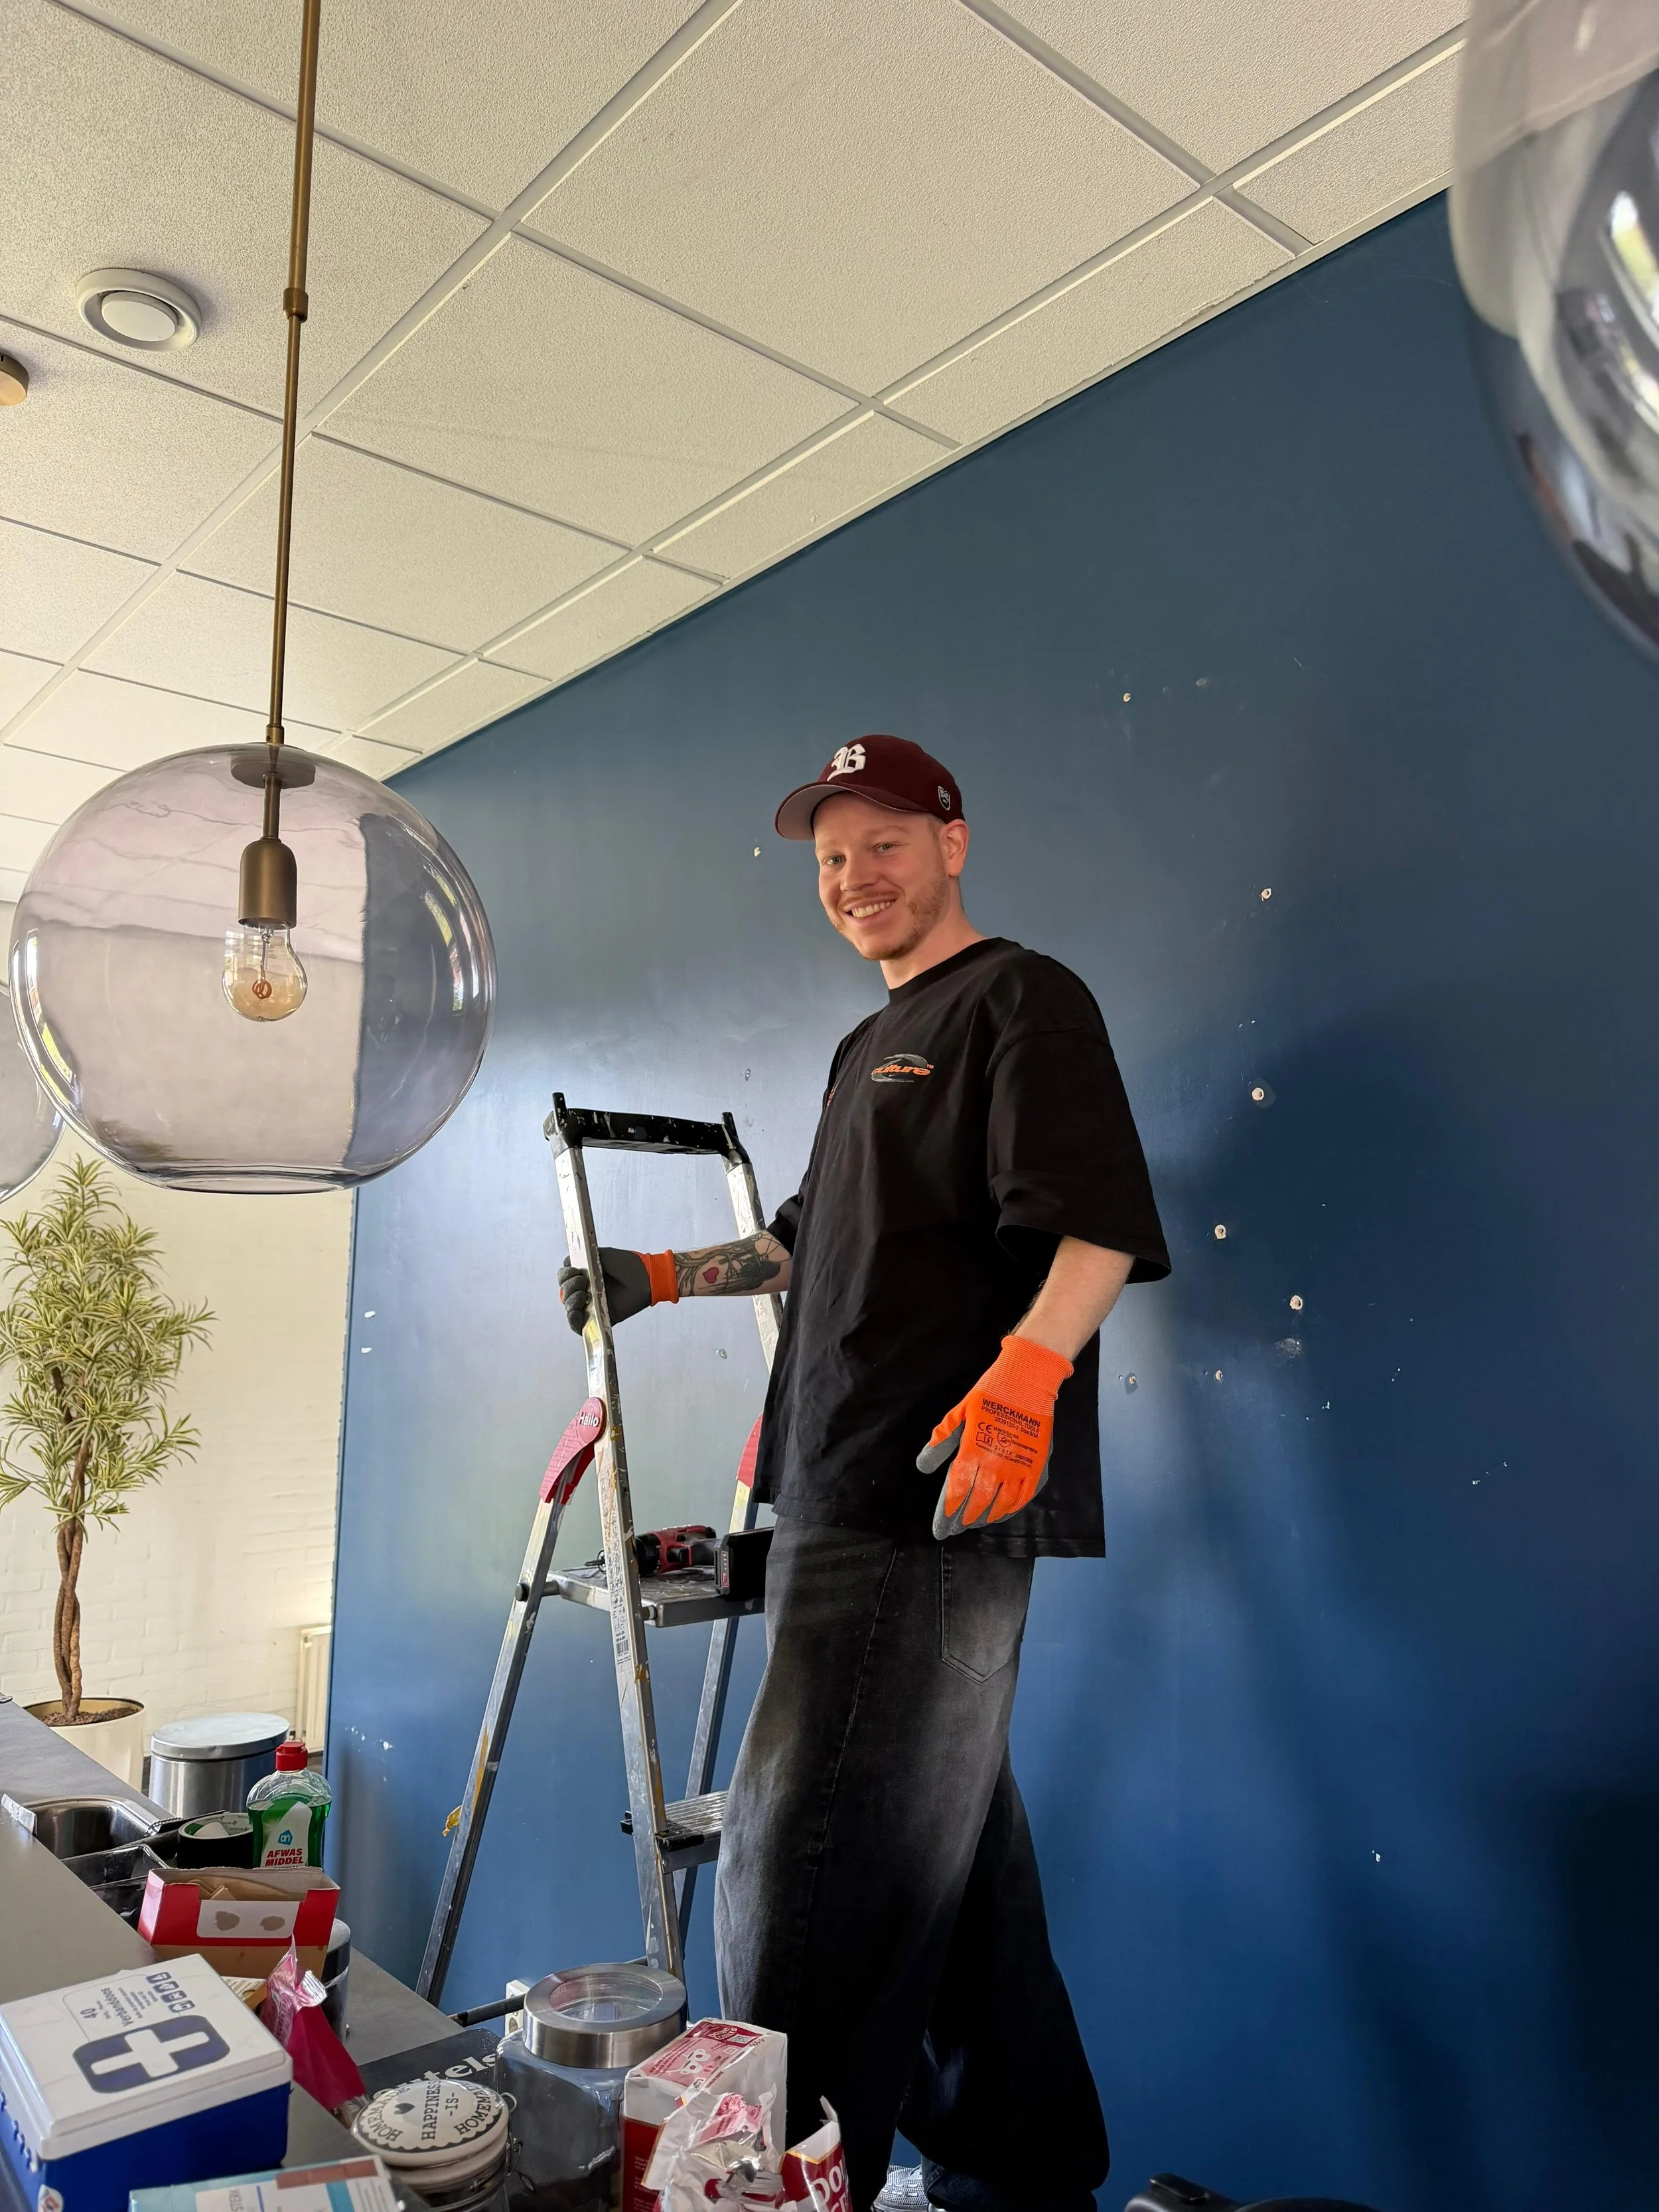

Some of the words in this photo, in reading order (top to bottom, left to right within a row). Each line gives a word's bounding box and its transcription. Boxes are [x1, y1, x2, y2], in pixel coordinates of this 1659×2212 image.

[827, 743, 866, 781] B
[579, 1412, 599, 1428] Hailo
[981, 1406, 1023, 1426] PROFESSIONAL
[1025, 1423, 1039, 1434] TOOLS
[982, 1398, 1041, 1428] WERCKMANN
[978, 1422, 993, 1434] CE
[265, 1856, 304, 1867] MIDDEL
[267, 1848, 303, 1858] AFWAS
[80, 2008, 98, 2019] 40
[101, 1988, 135, 2027] Verbanddoos
[421, 2079, 442, 2141] HAPPINESS
